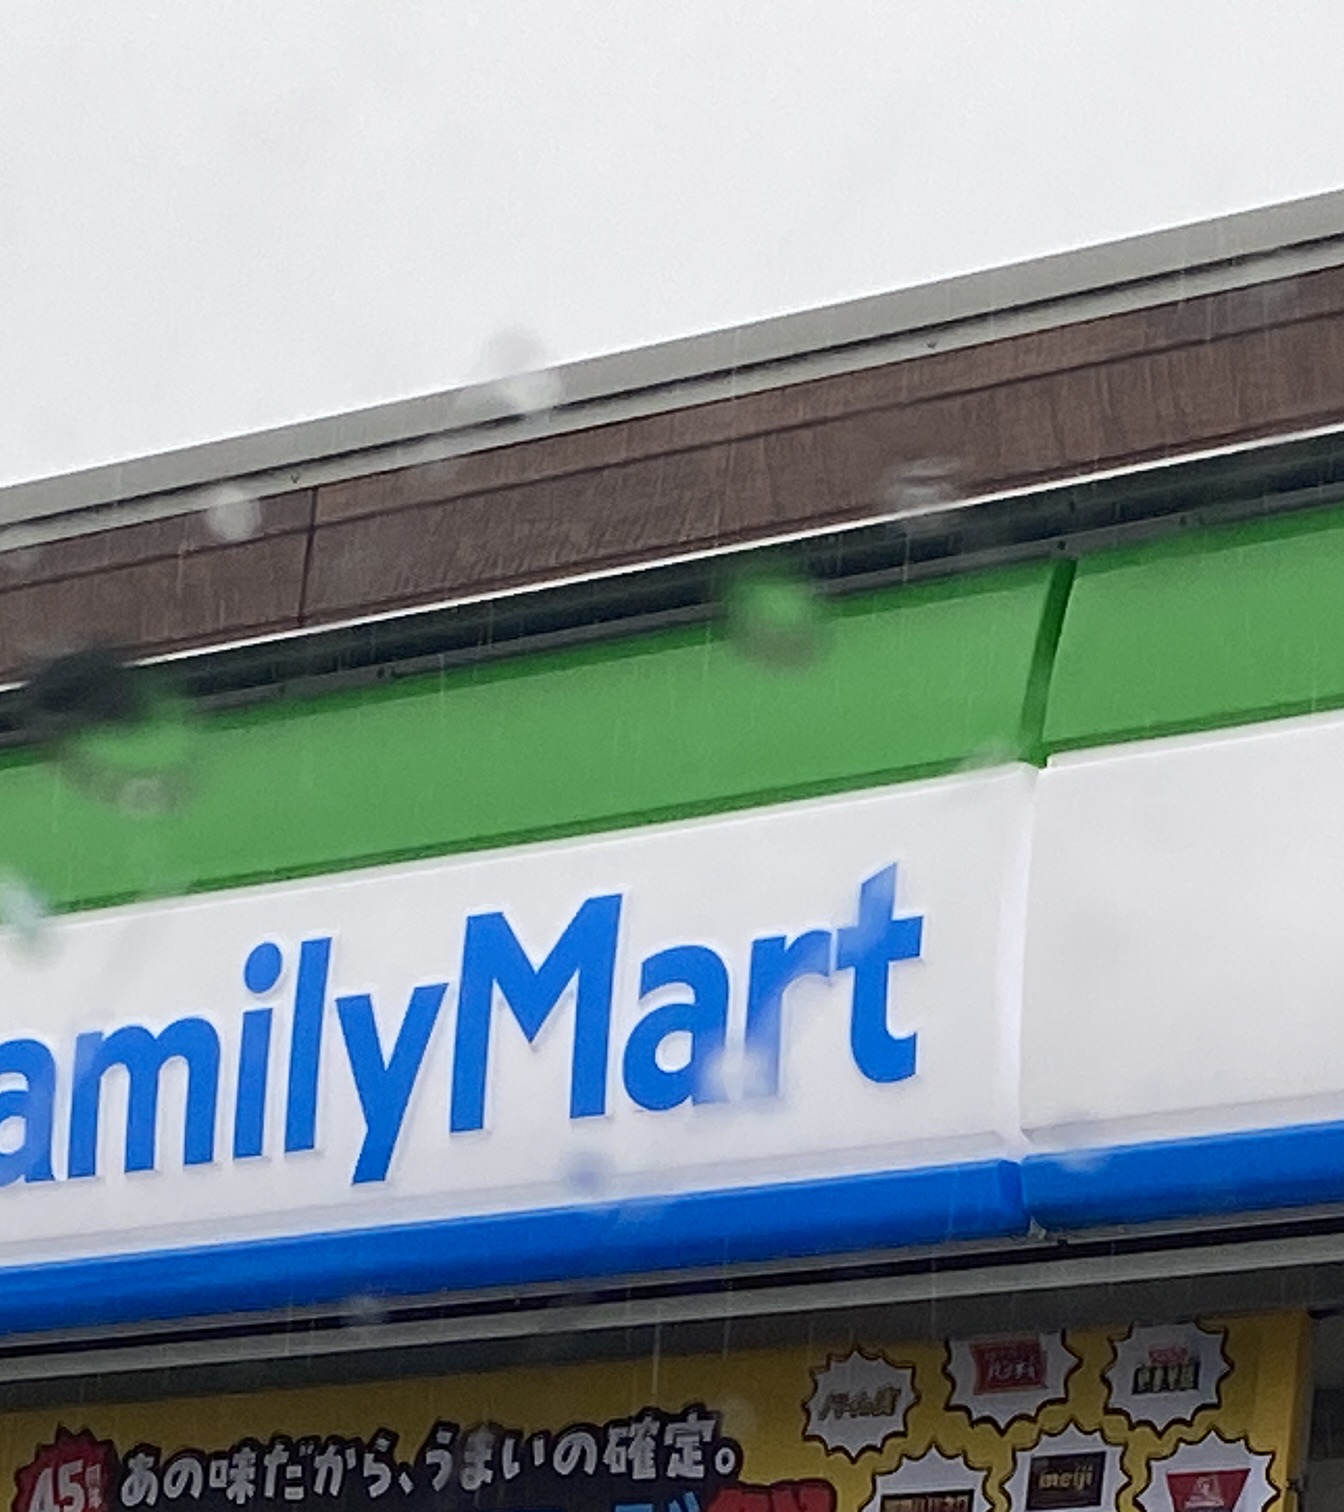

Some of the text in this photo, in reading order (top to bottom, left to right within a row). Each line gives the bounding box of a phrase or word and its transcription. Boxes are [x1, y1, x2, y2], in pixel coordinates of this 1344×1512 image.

[122, 1413, 737, 1507] あの味だから、うまいの確定。
[1038, 1464, 1096, 1492] meiji
